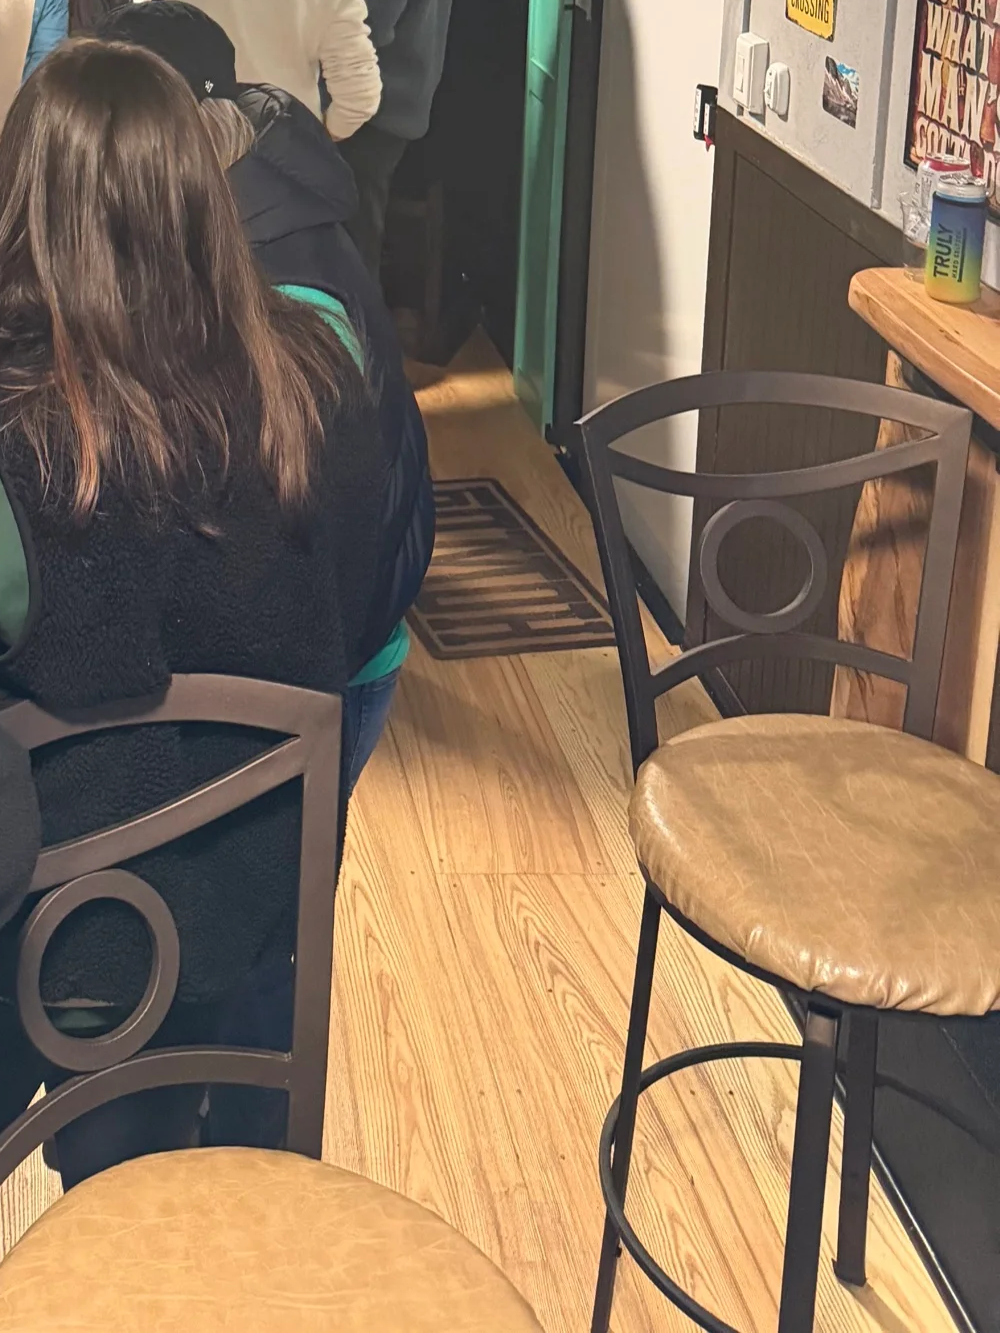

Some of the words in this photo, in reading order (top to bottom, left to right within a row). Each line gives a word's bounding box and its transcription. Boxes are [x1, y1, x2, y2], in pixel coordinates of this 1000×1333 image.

[925, 2, 995, 78] WHAT
[933, 222, 953, 278] TRULY
[952, 259, 960, 279] HARD
